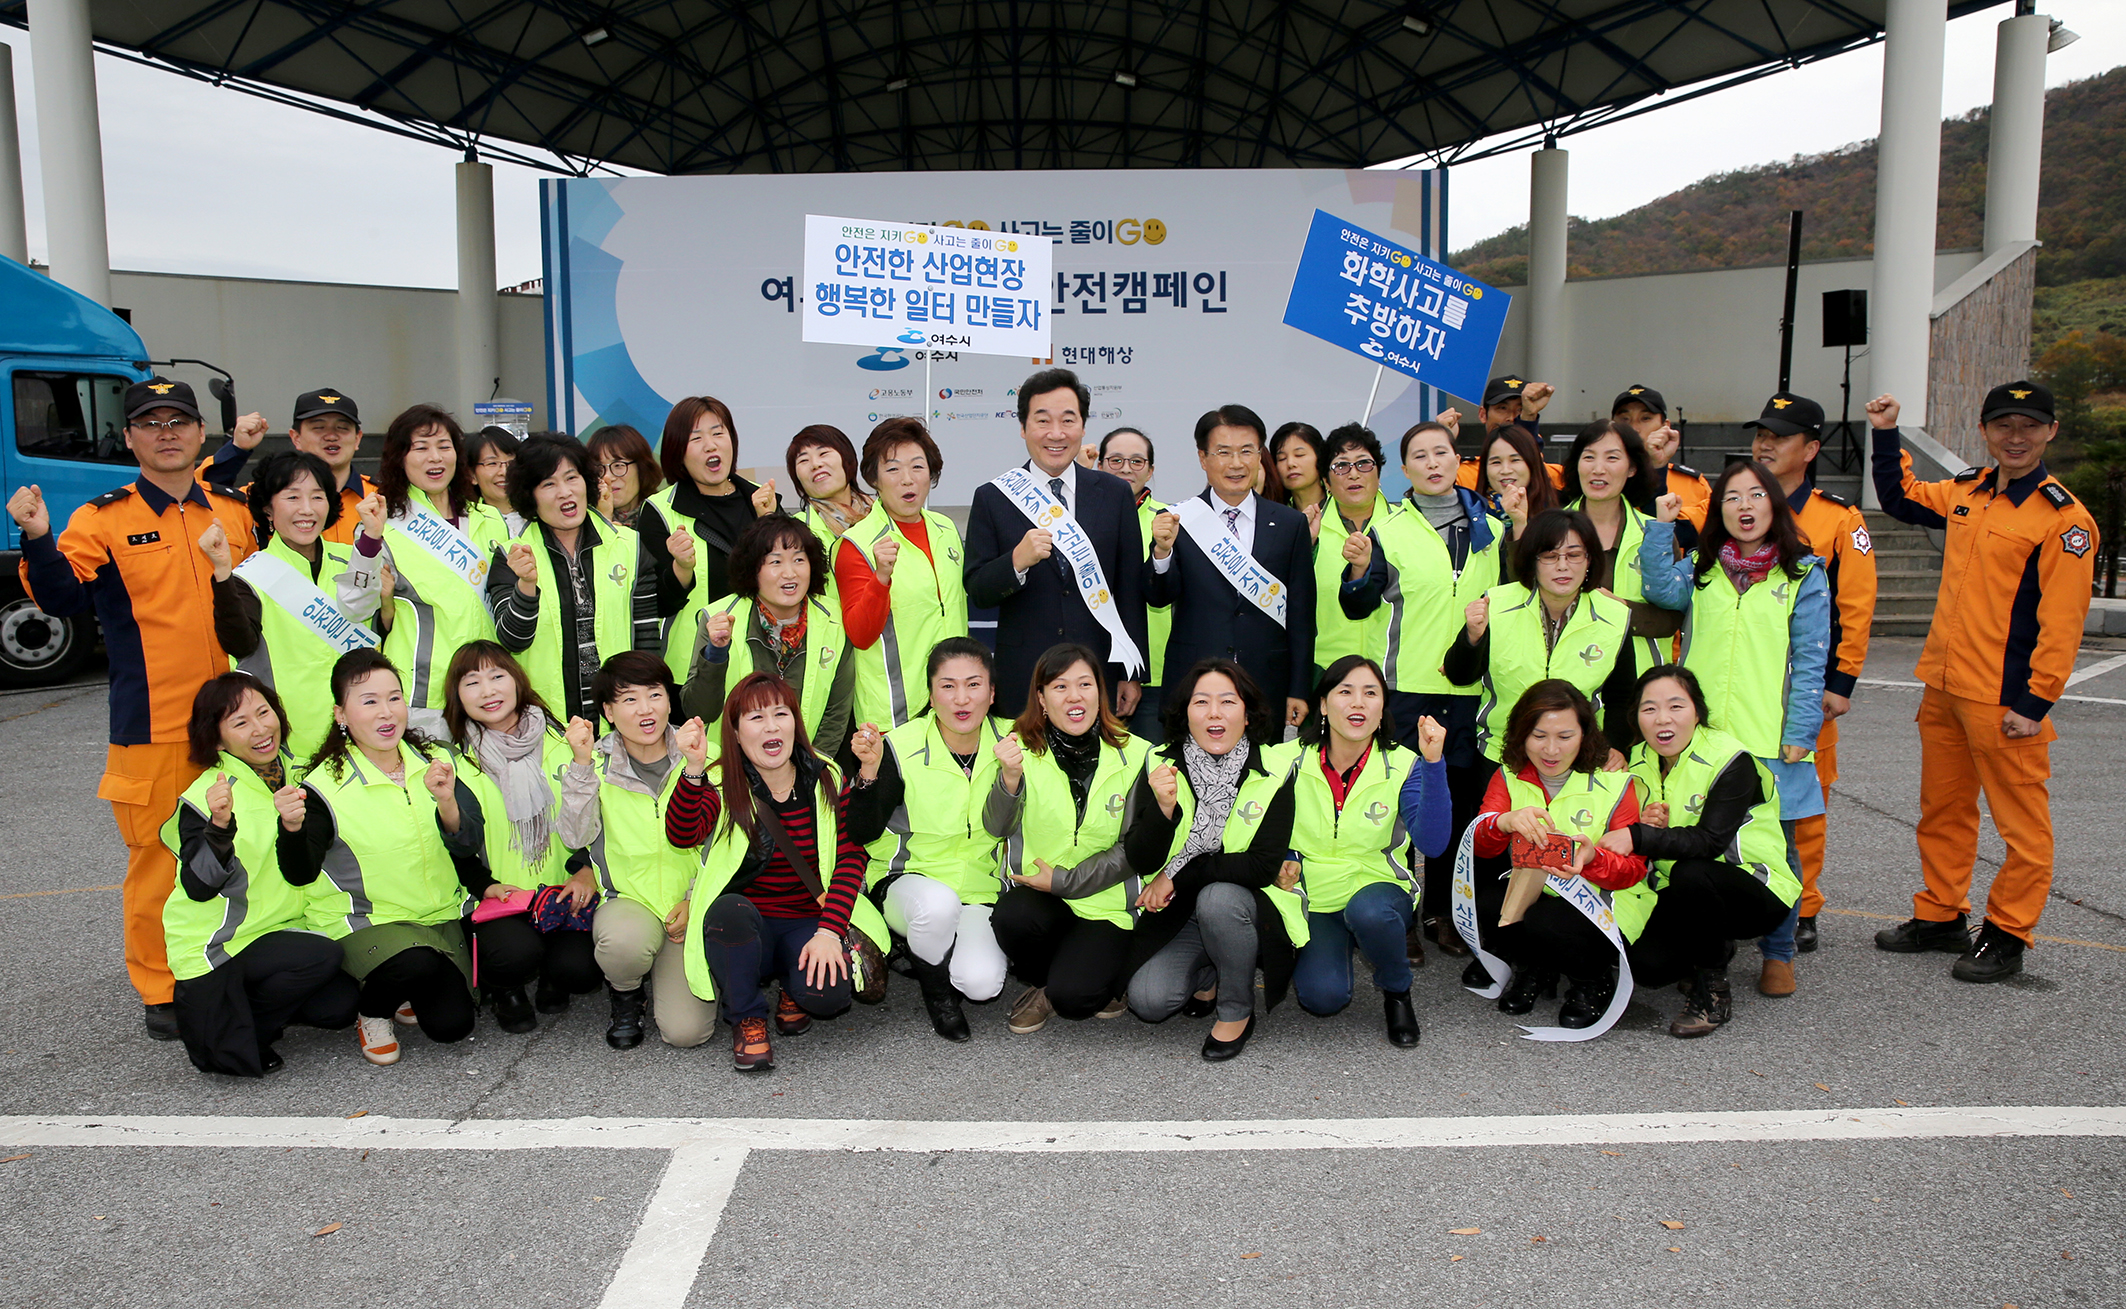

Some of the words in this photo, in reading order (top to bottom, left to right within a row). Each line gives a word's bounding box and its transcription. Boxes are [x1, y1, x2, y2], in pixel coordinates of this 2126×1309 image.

[841, 225, 876, 240] 안전은
[933, 234, 967, 249] 사고는
[1340, 228, 1370, 250] 안전은
[1413, 261, 1442, 283] 사고는
[834, 243, 915, 282] 안전한
[921, 251, 1026, 291] 산업현장
[815, 282, 897, 320] 행복한
[905, 289, 955, 325] 일터
[965, 293, 1042, 331] 만들자
[1339, 250, 1470, 331] 화학사고를
[930, 333, 972, 347] 여수시
[1343, 292, 1447, 361] 추방하자
[1061, 346, 1134, 365] 현대해상
[1387, 351, 1422, 374] 여수시
[406, 512, 453, 551] 안전은
[1056, 522, 1091, 563] 사고는
[1210, 536, 1248, 576] 안전은
[303, 596, 350, 640] 안전은
[1456, 902, 1477, 944] 사고는
